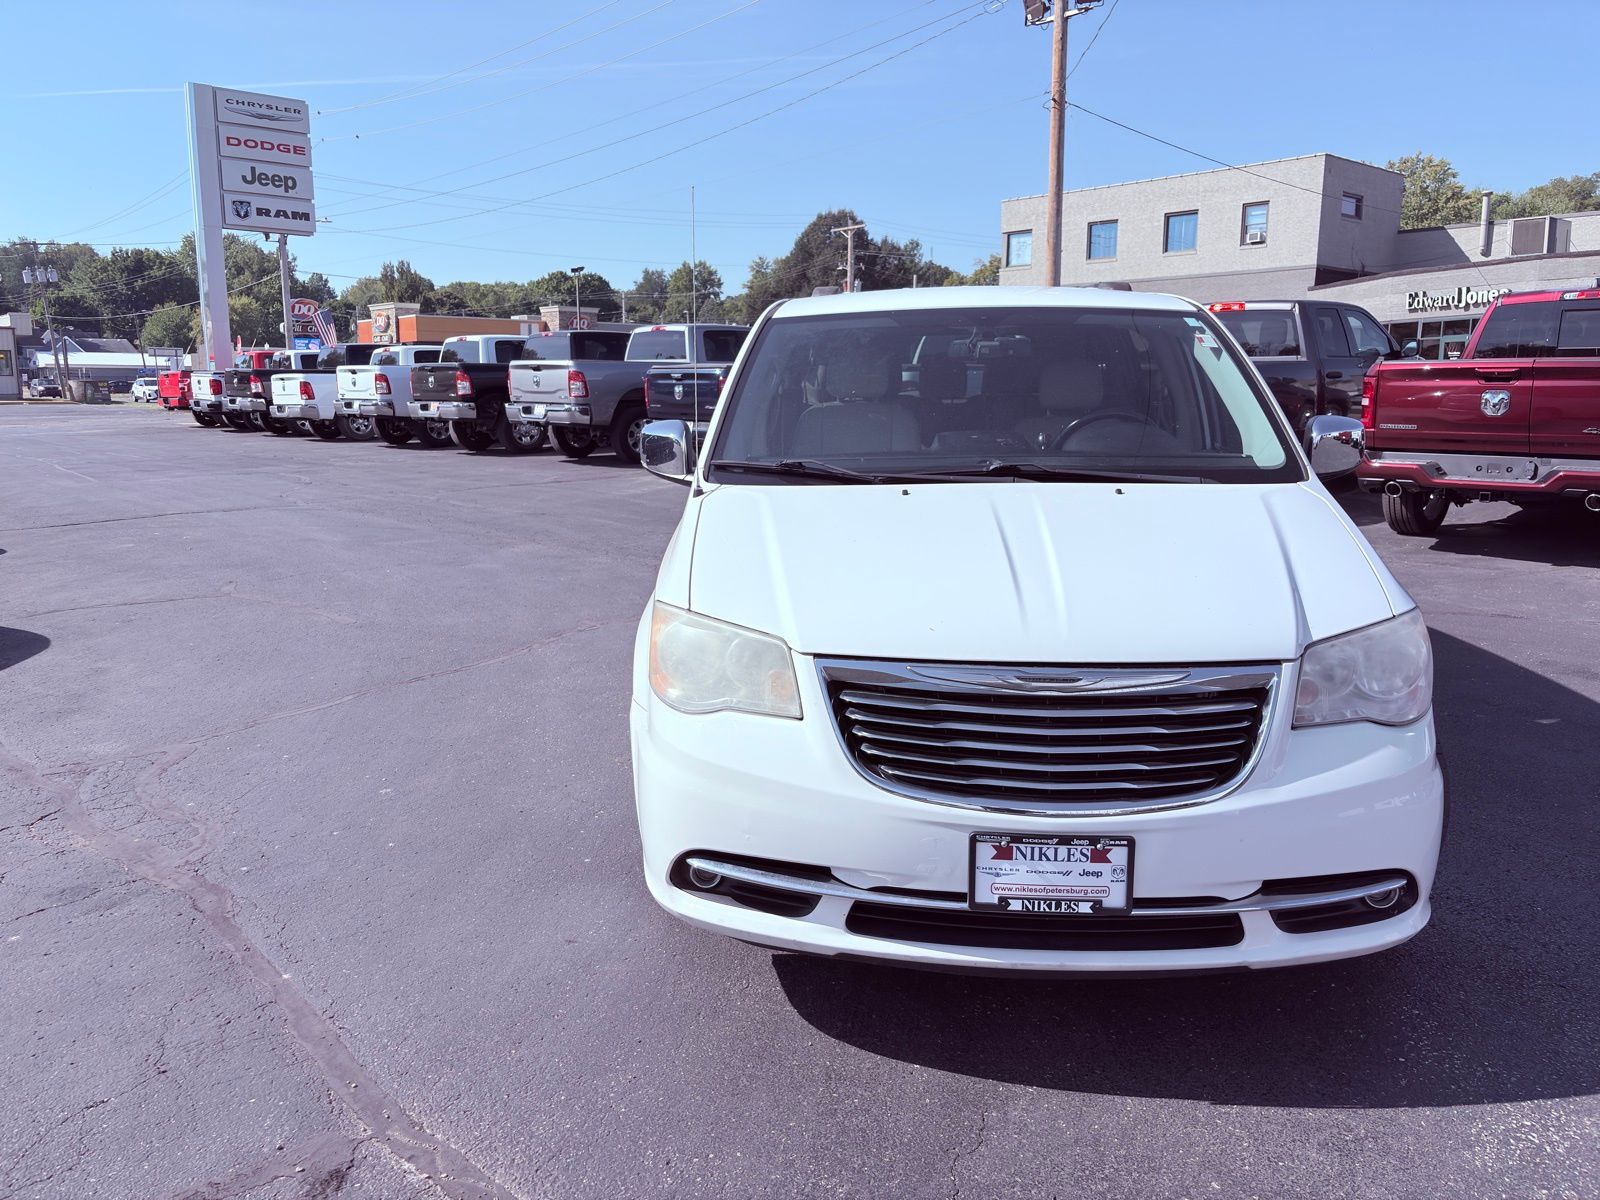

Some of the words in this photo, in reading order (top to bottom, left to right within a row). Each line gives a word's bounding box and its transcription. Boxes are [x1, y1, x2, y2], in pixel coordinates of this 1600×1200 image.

[225, 98, 302, 115] CHRYSLER
[226, 136, 306, 156] DODGE
[241, 166, 297, 193] Jeep
[256, 207, 311, 222] RAM
[1405, 287, 1458, 309] Edward
[293, 303, 315, 317] DQ
[572, 319, 588, 330] DQ
[1014, 845, 1090, 862] NIKLES
[1078, 869, 1103, 878] Jeep
[993, 886, 1108, 896] www.niklesofpetersburg.com
[1021, 899, 1080, 913] NIKLES
